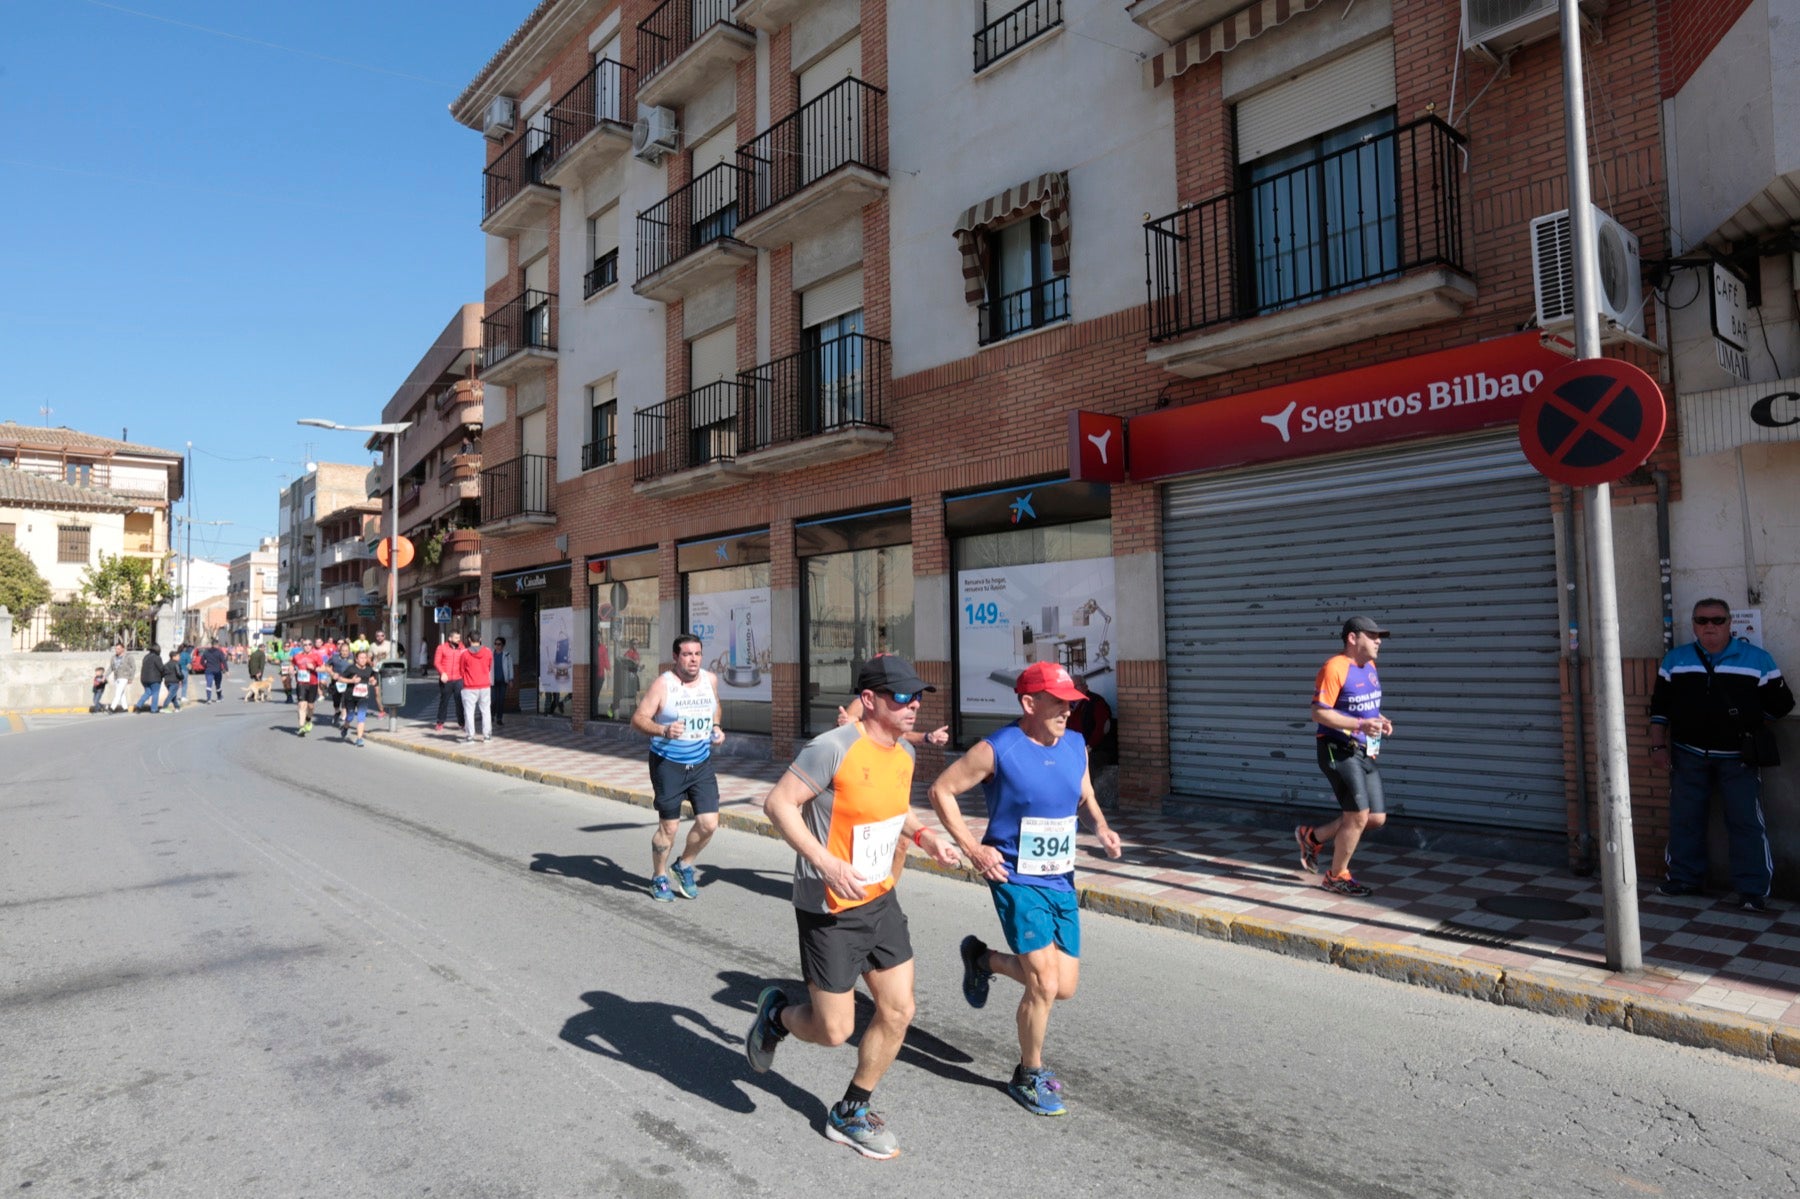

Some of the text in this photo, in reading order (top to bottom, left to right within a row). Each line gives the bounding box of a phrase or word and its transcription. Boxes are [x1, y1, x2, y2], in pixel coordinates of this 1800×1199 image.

[1715, 274, 1739, 308] CAFÉ
[1731, 315, 1748, 342] BAR
[1301, 369, 1544, 433] Seguros Bilbao
[965, 602, 998, 625] 149
[1348, 701, 1375, 712] DONA
[1032, 835, 1069, 857] 394
